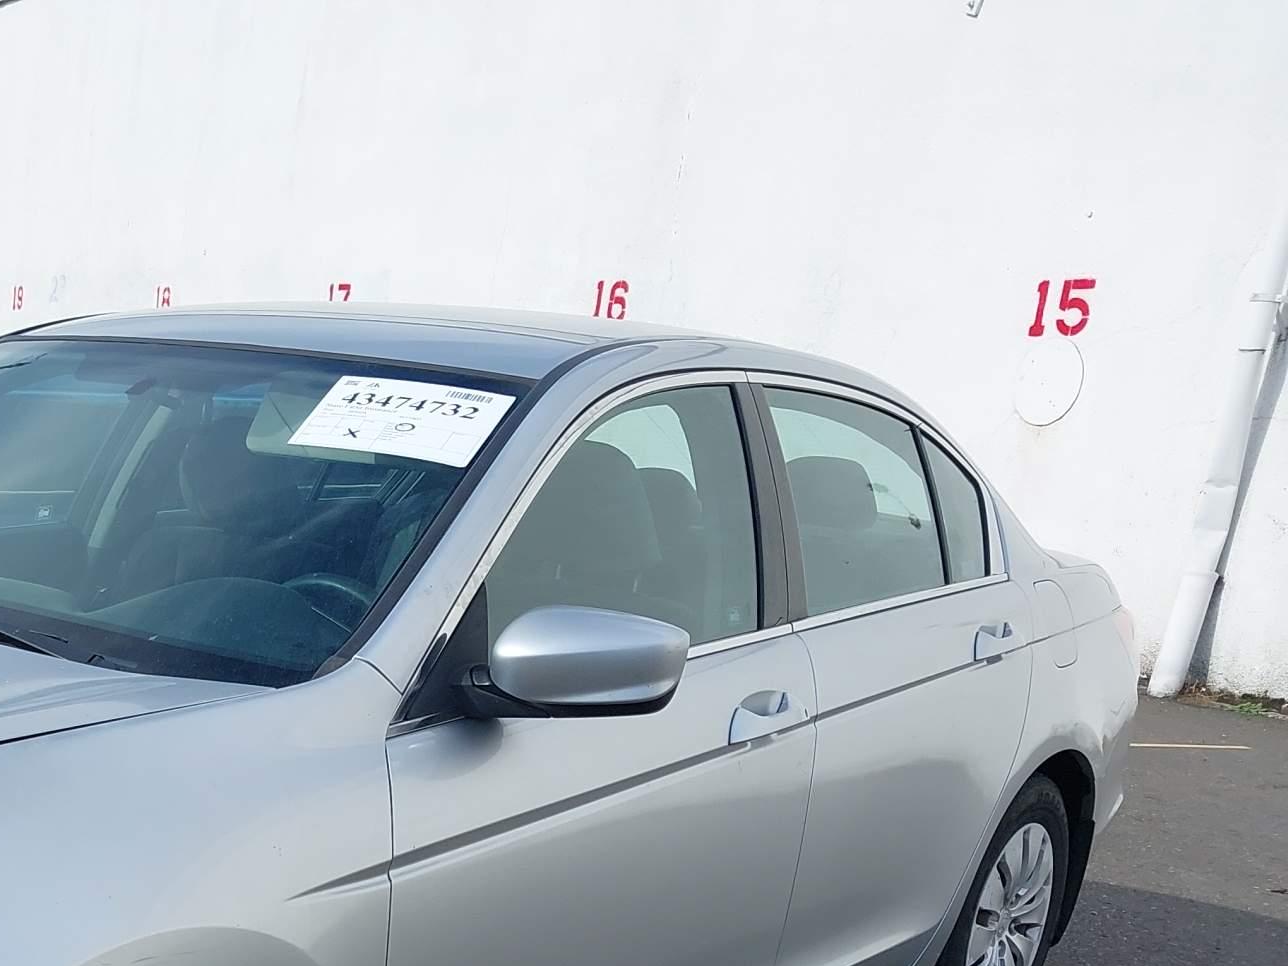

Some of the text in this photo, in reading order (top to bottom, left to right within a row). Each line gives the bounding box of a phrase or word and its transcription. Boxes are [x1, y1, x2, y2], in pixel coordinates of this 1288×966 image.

[12, 285, 24, 311] 19
[329, 283, 351, 302] 17
[592, 280, 629, 320] 16
[1028, 278, 1096, 337] 15
[341, 391, 480, 420] 43474732
